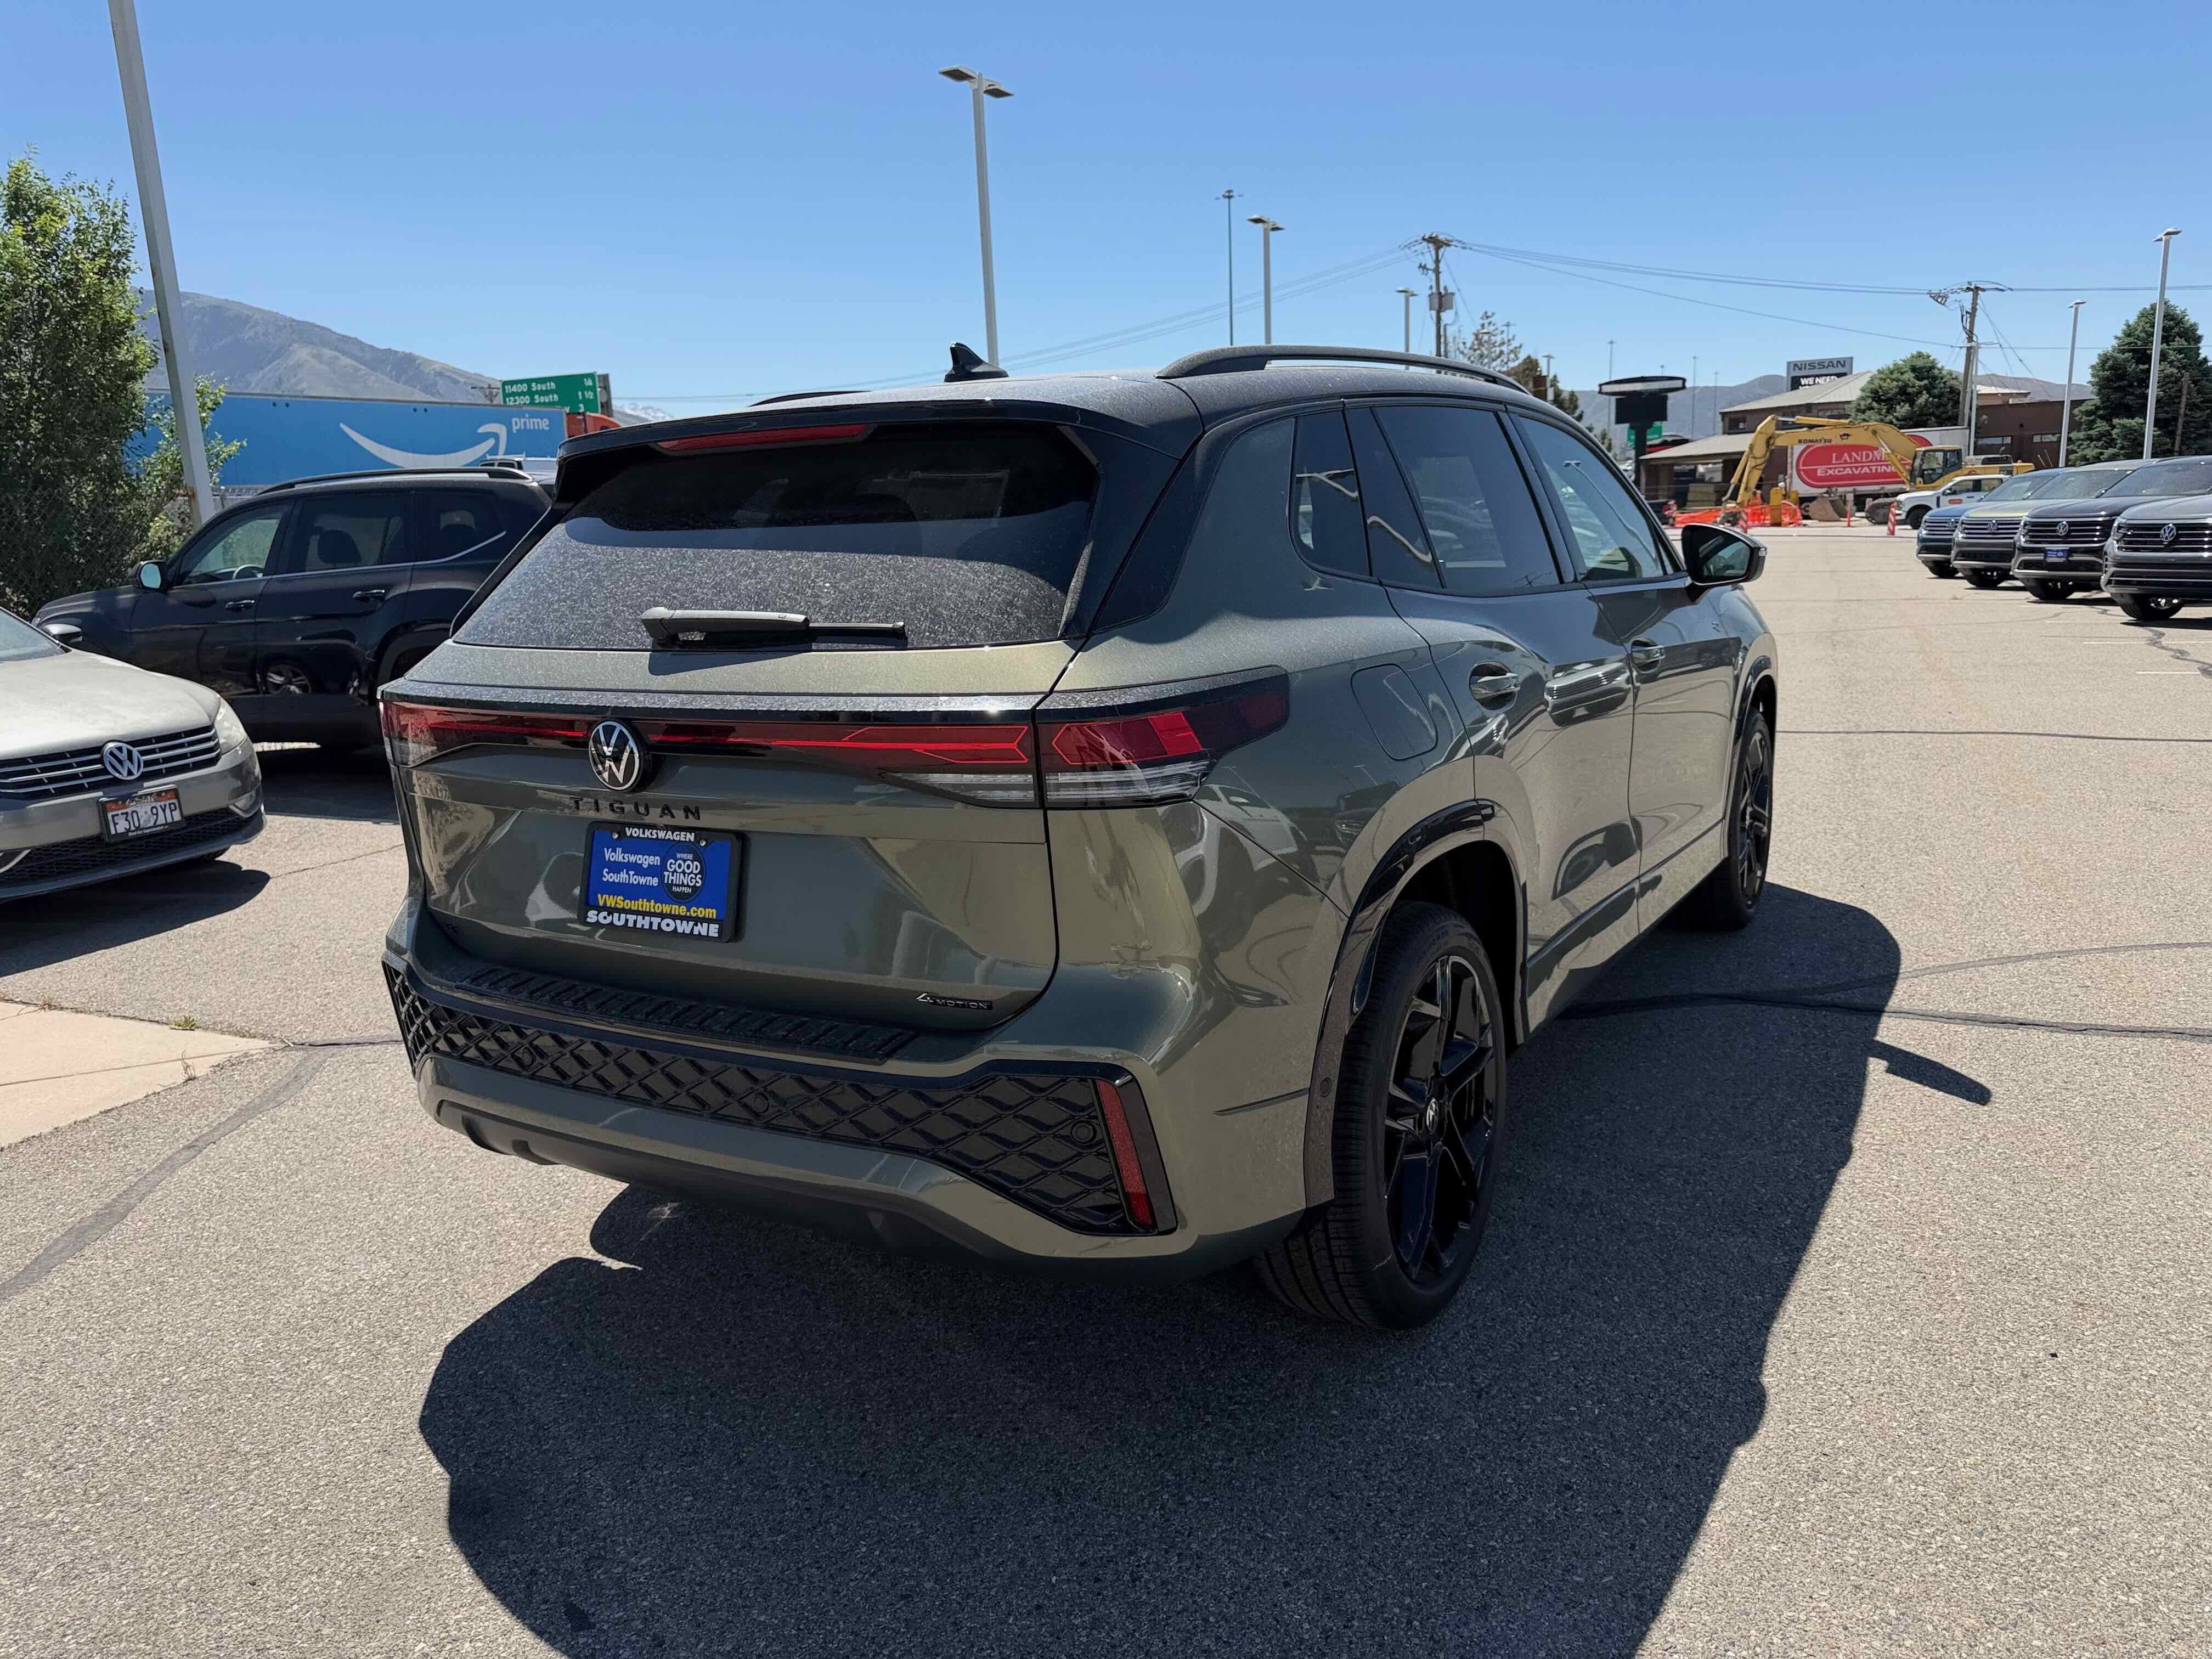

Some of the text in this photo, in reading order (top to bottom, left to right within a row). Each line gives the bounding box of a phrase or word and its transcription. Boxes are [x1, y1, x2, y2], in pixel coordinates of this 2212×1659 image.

[1793, 360, 1846, 371] NISSAN
[505, 383, 528, 393] 11400
[531, 382, 556, 391] South
[1800, 377, 1814, 385] WE
[506, 395, 531, 405] 12300
[534, 393, 558, 403] South
[511, 415, 550, 433] prime
[1832, 450, 1886, 464] LANDM
[150, 802, 177, 826] 9YP
[569, 797, 702, 821] TIGUAN
[625, 827, 695, 842] VOLKSWAGEN
[603, 848, 661, 868] Volkswagen
[676, 852, 693, 860] WHERE
[667, 859, 701, 873] GOOD
[602, 868, 658, 887] SouthTowne
[663, 871, 702, 887] THINGS
[672, 885, 692, 894] HAPPEN
[597, 894, 716, 919] VWSouthtowne.com
[585, 909, 719, 938] SOUTHTOWNE
